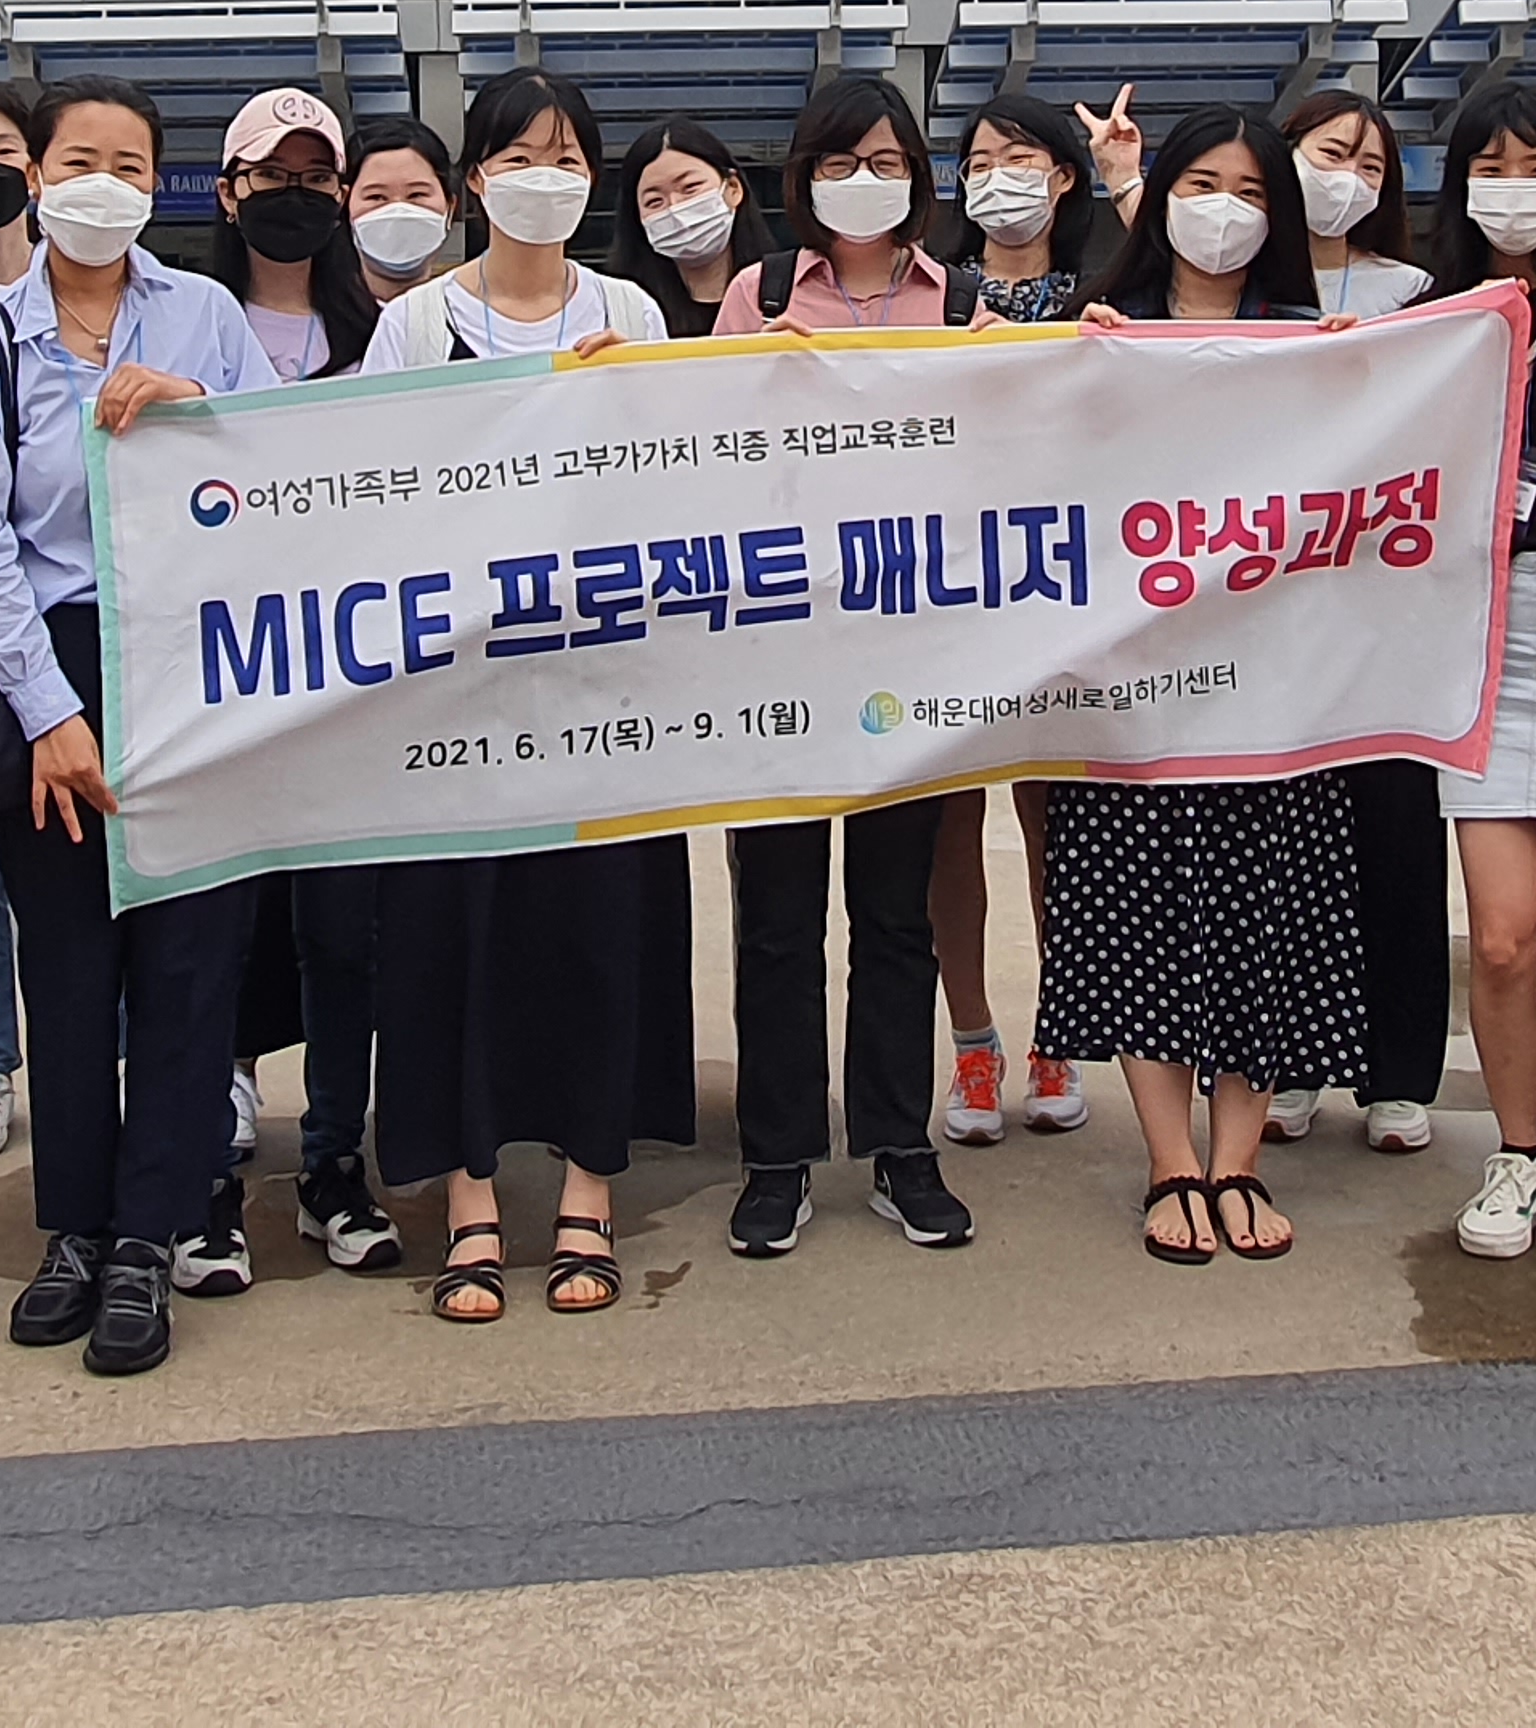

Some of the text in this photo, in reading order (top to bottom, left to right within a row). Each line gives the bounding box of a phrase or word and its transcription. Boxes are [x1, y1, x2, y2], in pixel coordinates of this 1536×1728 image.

[246, 416, 955, 516] 여성가족부 2021년 고부가가치 직종 직업교육훈련
[199, 468, 1440, 705] MICE 프로젝트 매니저 양성과정
[405, 738, 503, 770] 2021.
[515, 733, 546, 761] 6.
[560, 716, 655, 757] 17(목)
[693, 712, 724, 739] 9.
[738, 700, 811, 738] 1(월)
[912, 661, 1238, 728] 해운대여성새로일하기센터
